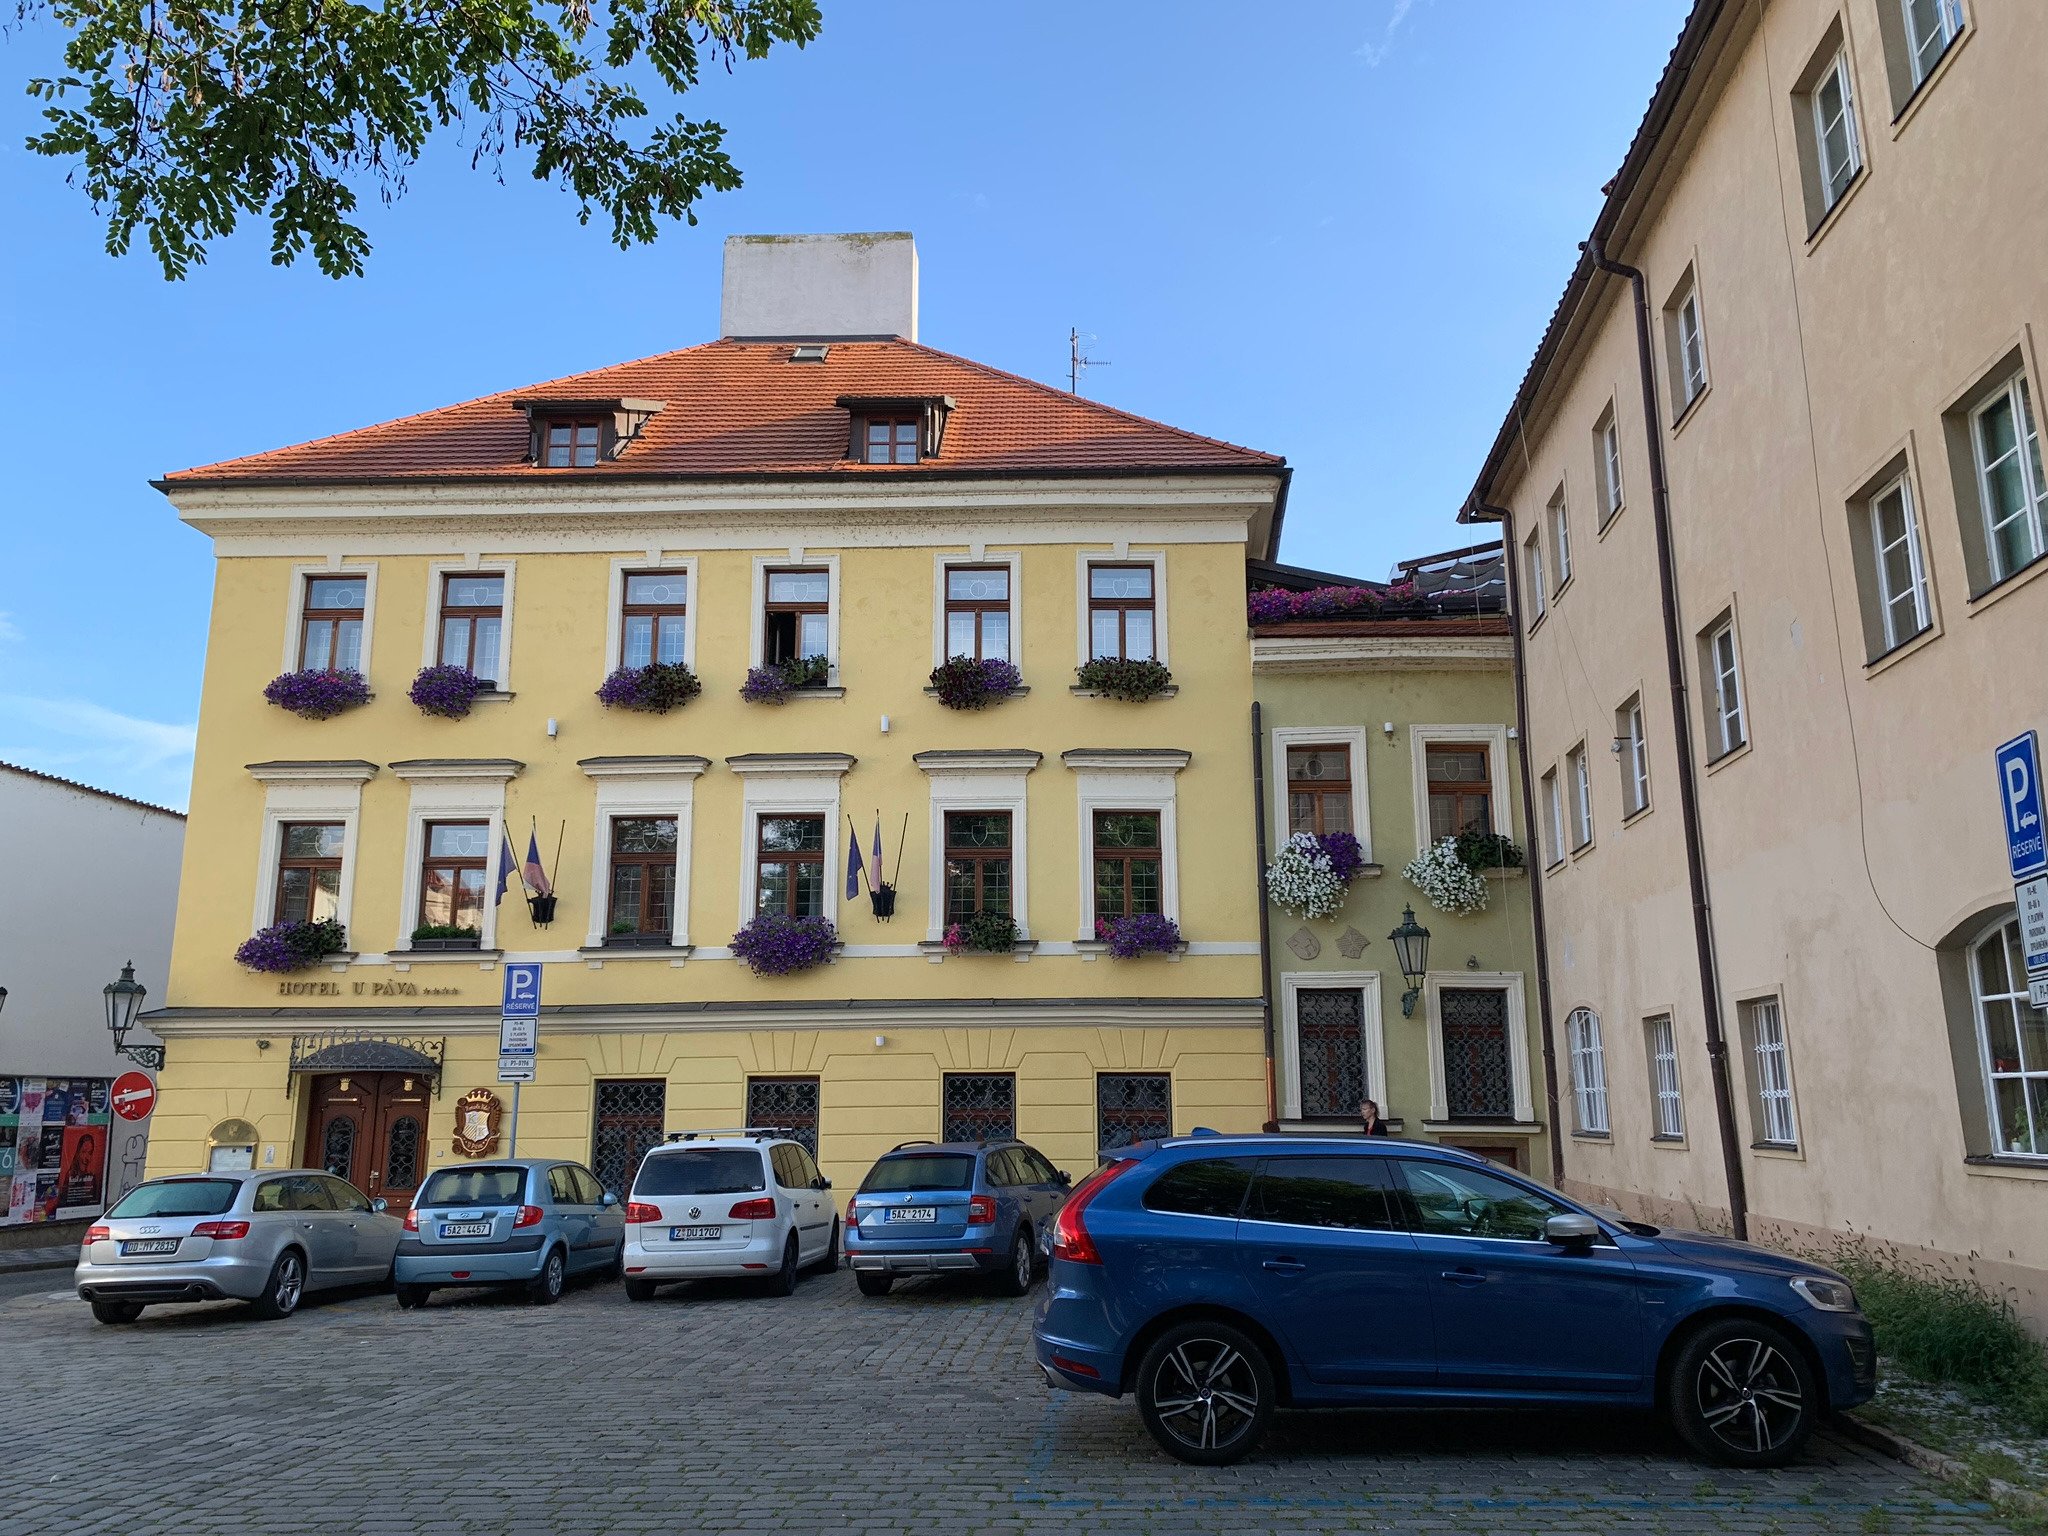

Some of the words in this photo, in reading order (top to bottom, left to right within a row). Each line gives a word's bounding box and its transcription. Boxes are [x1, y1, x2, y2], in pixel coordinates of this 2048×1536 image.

[2005, 757, 2029, 833] P
[2012, 832, 2042, 859] RÉSERVÉ
[279, 982, 340, 996] HOTEL
[352, 982, 365, 996] U
[372, 978, 418, 996] PÁVA
[511, 970, 533, 999] P
[506, 1002, 536, 1010] RÉSERVÉ
[912, 1208, 931, 1219] 2174
[467, 1225, 486, 1235] 4457
[699, 1228, 719, 1237] 1707
[155, 1240, 175, 1251] 2815
